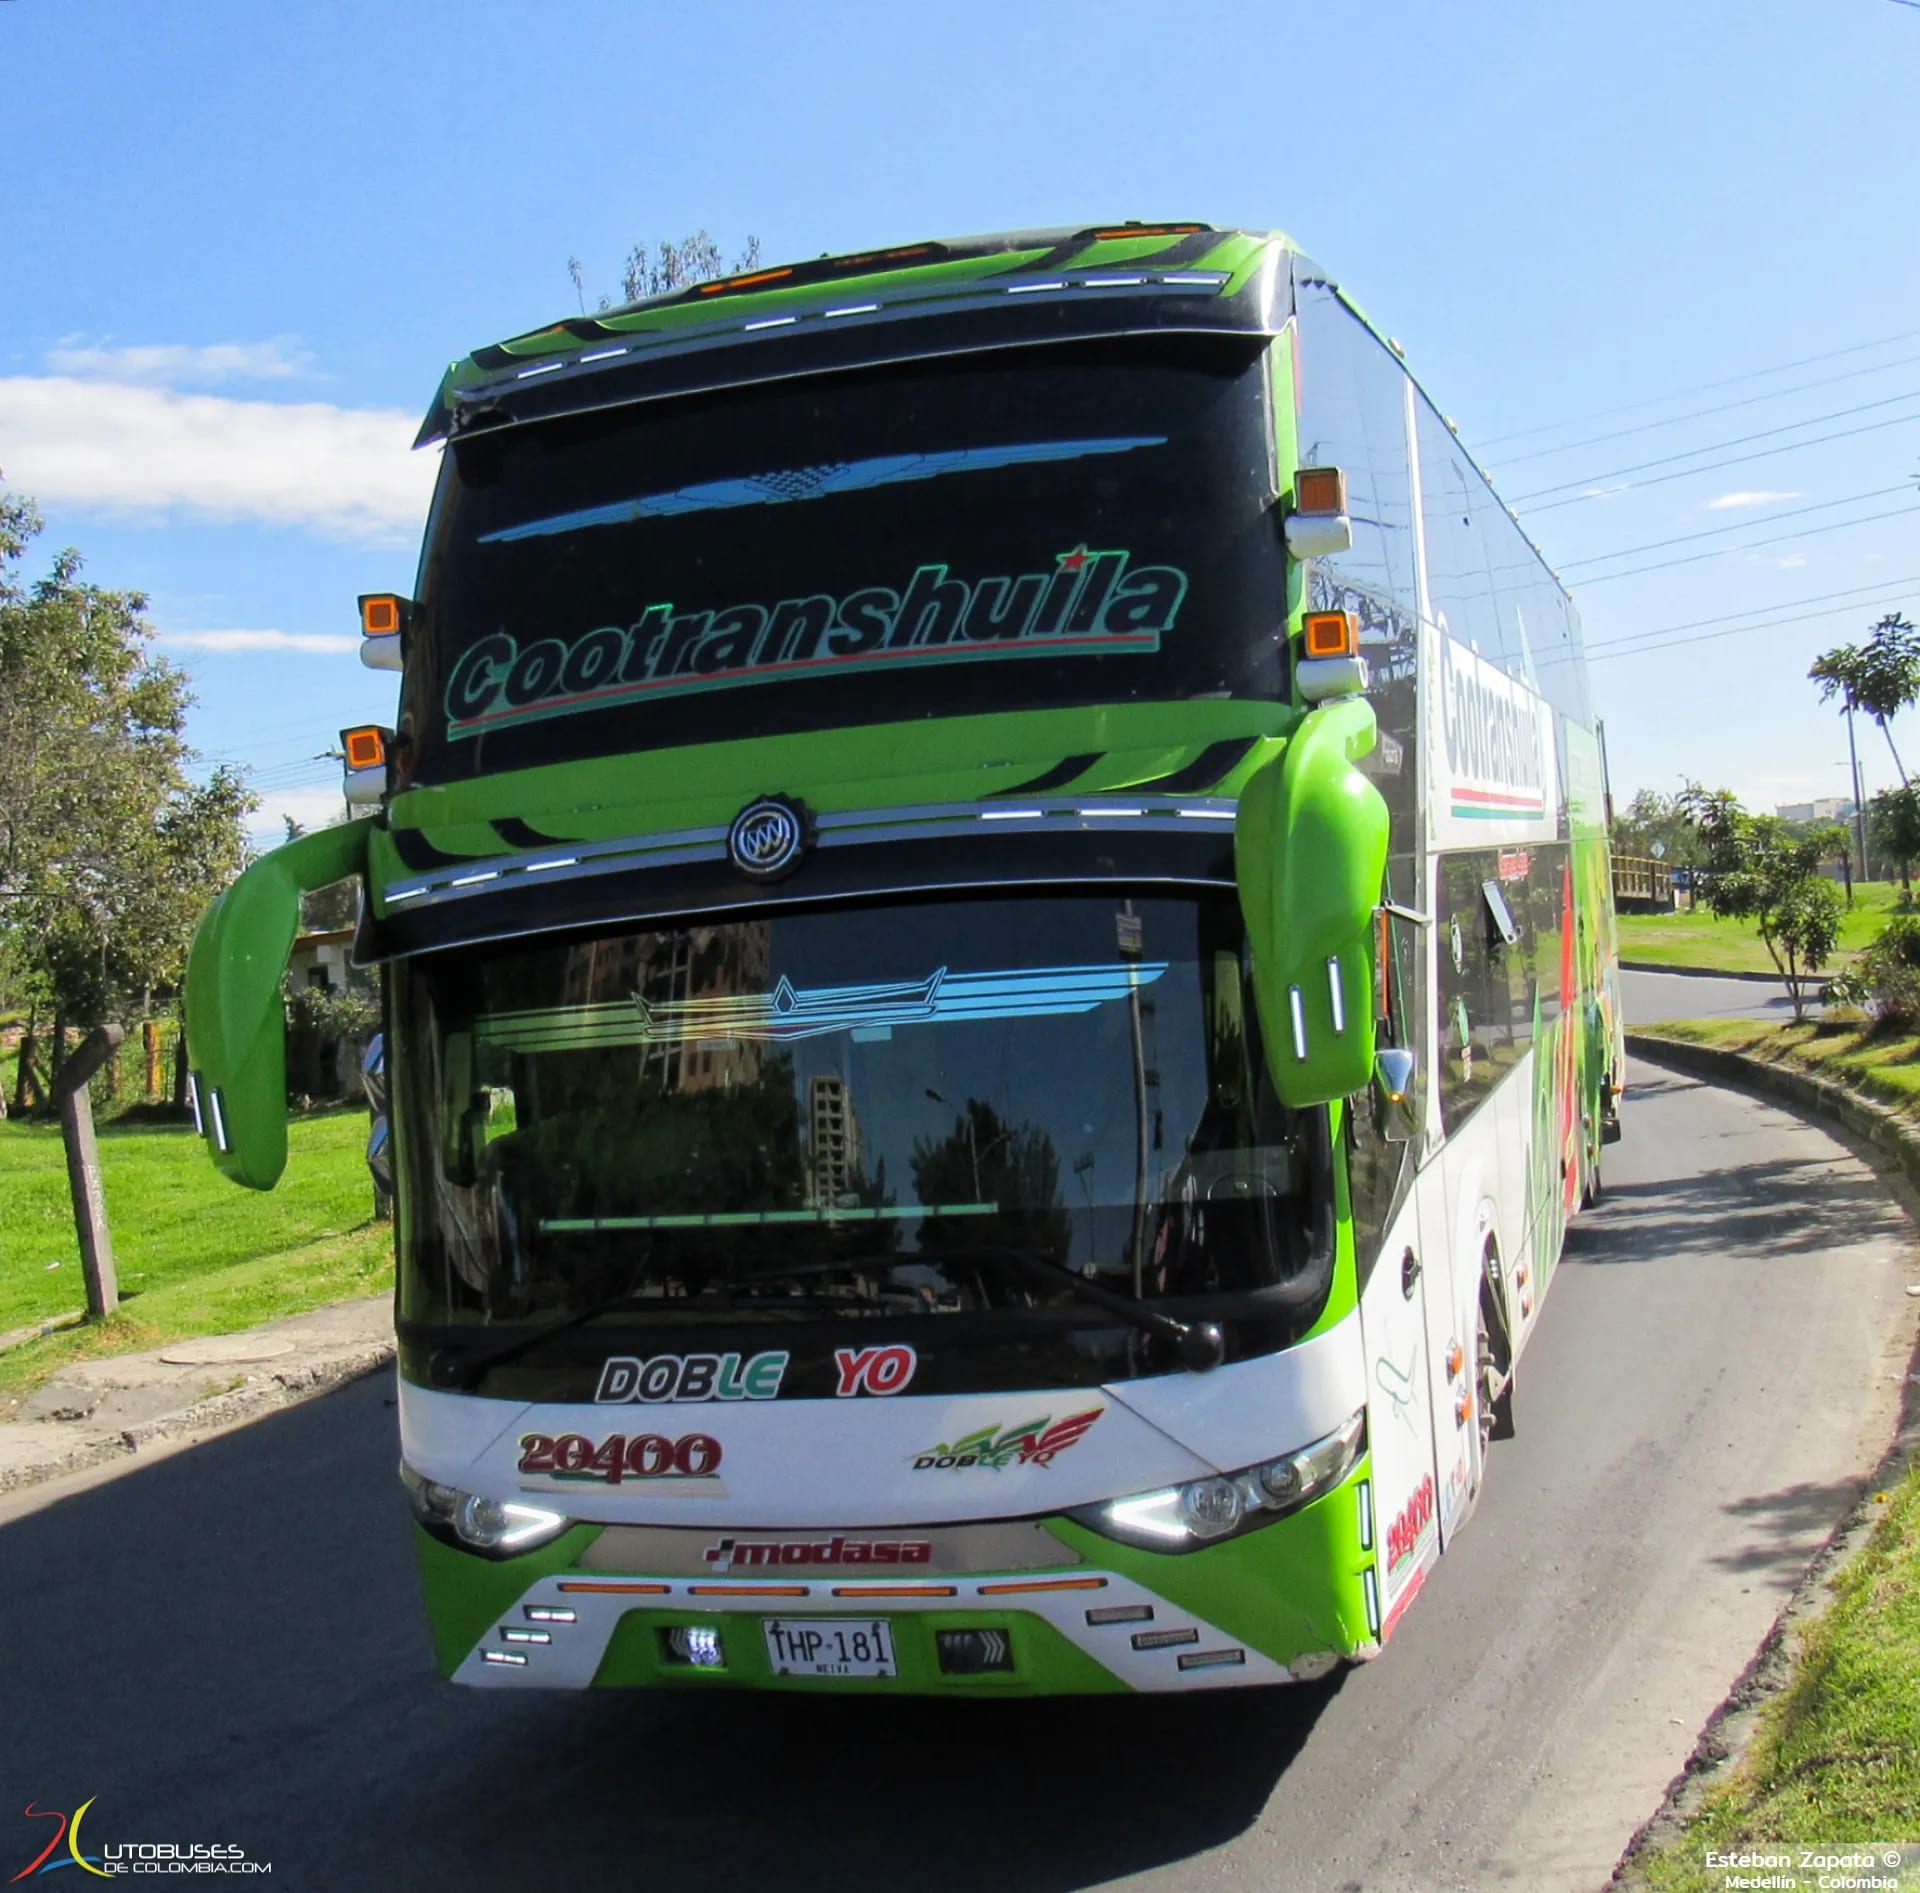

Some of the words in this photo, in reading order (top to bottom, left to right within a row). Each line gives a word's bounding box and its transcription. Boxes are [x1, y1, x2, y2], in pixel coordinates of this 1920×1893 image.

[446, 546, 1191, 724] Cootranshuila
[595, 1351, 790, 1403] DOBLE
[834, 1345, 917, 1397] YO
[518, 1433, 723, 1484] 20400
[733, 1535, 932, 1565] modasa
[769, 1629, 888, 1662] THP-181
